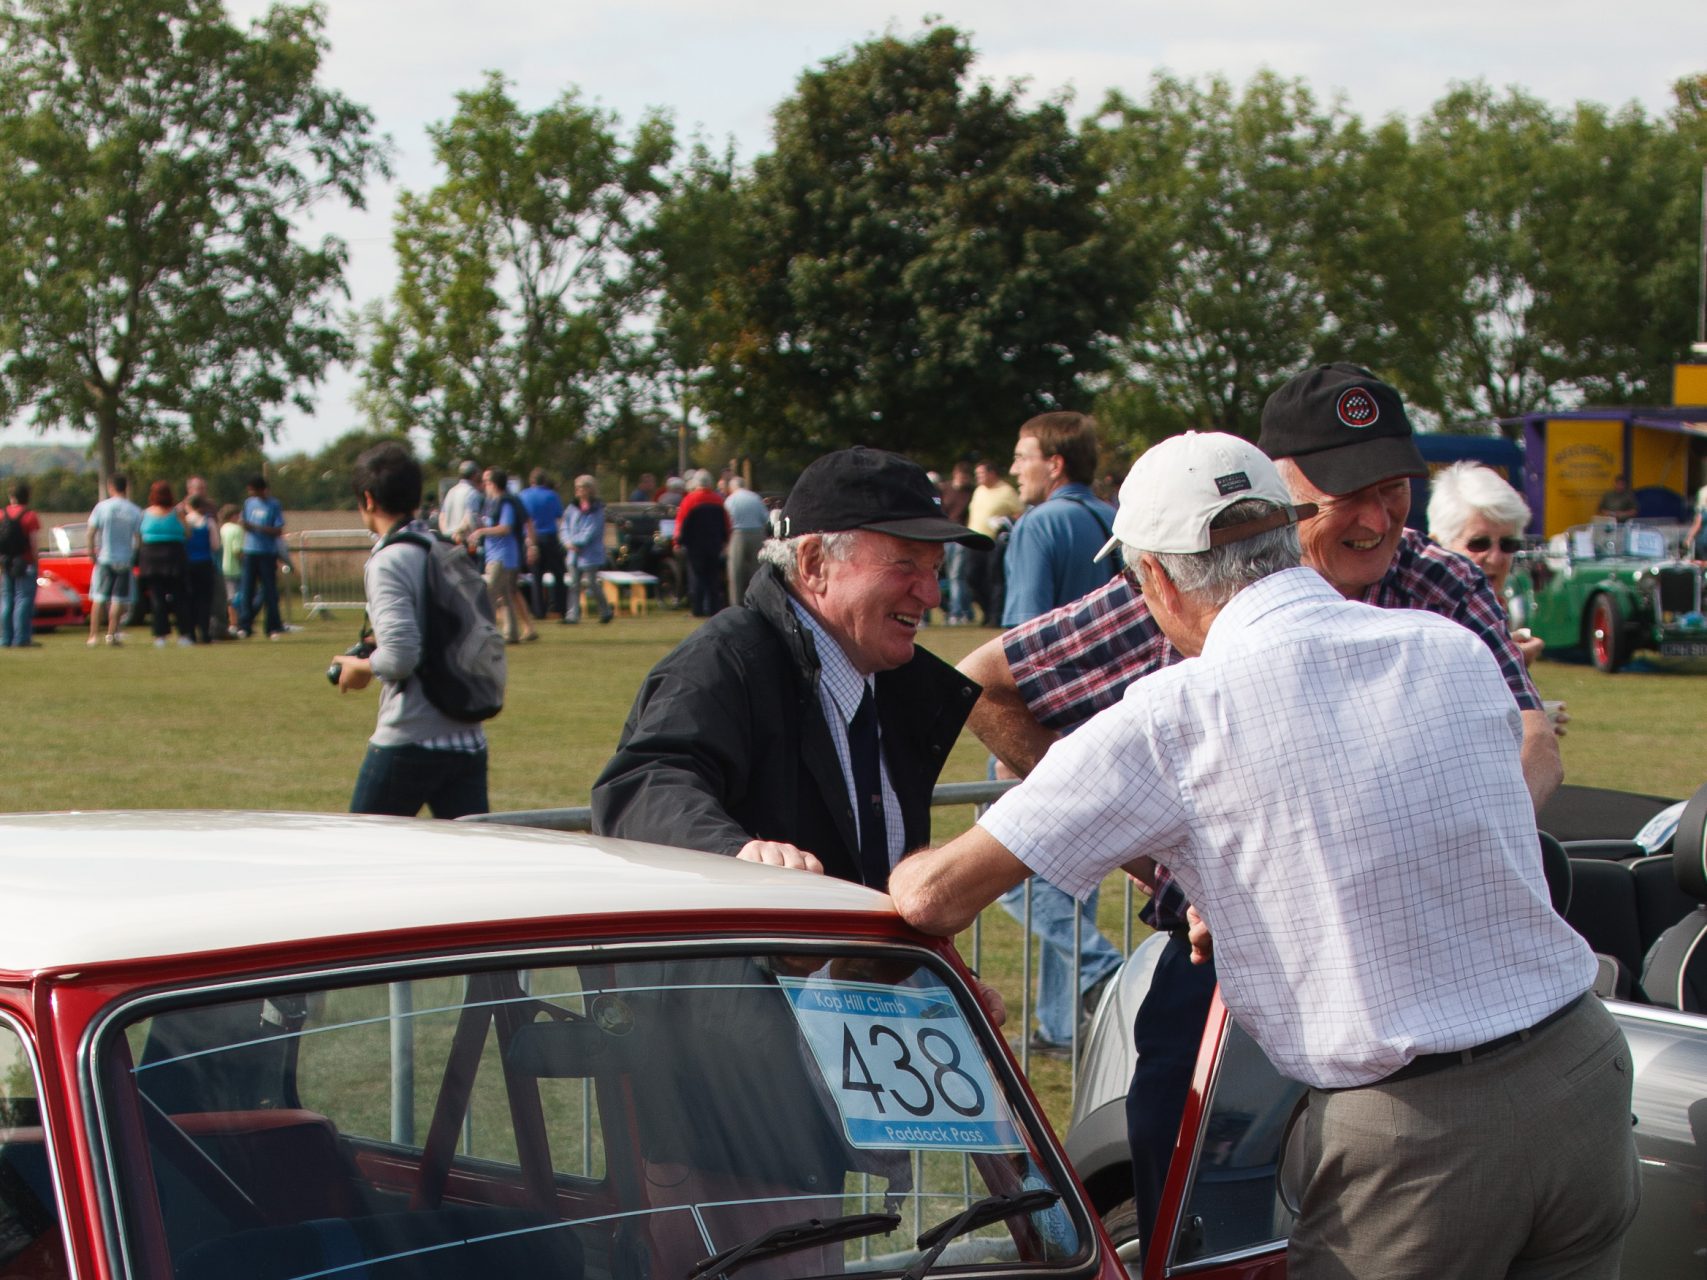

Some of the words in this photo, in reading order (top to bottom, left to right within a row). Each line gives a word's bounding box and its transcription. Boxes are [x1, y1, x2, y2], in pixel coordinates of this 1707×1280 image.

[814, 992, 843, 1013] Kop
[845, 994, 866, 1011] Hill
[867, 997, 907, 1014] Climb
[842, 1021, 985, 1117] 438
[885, 1126, 951, 1142] Paddock
[952, 1127, 983, 1142] Pass
